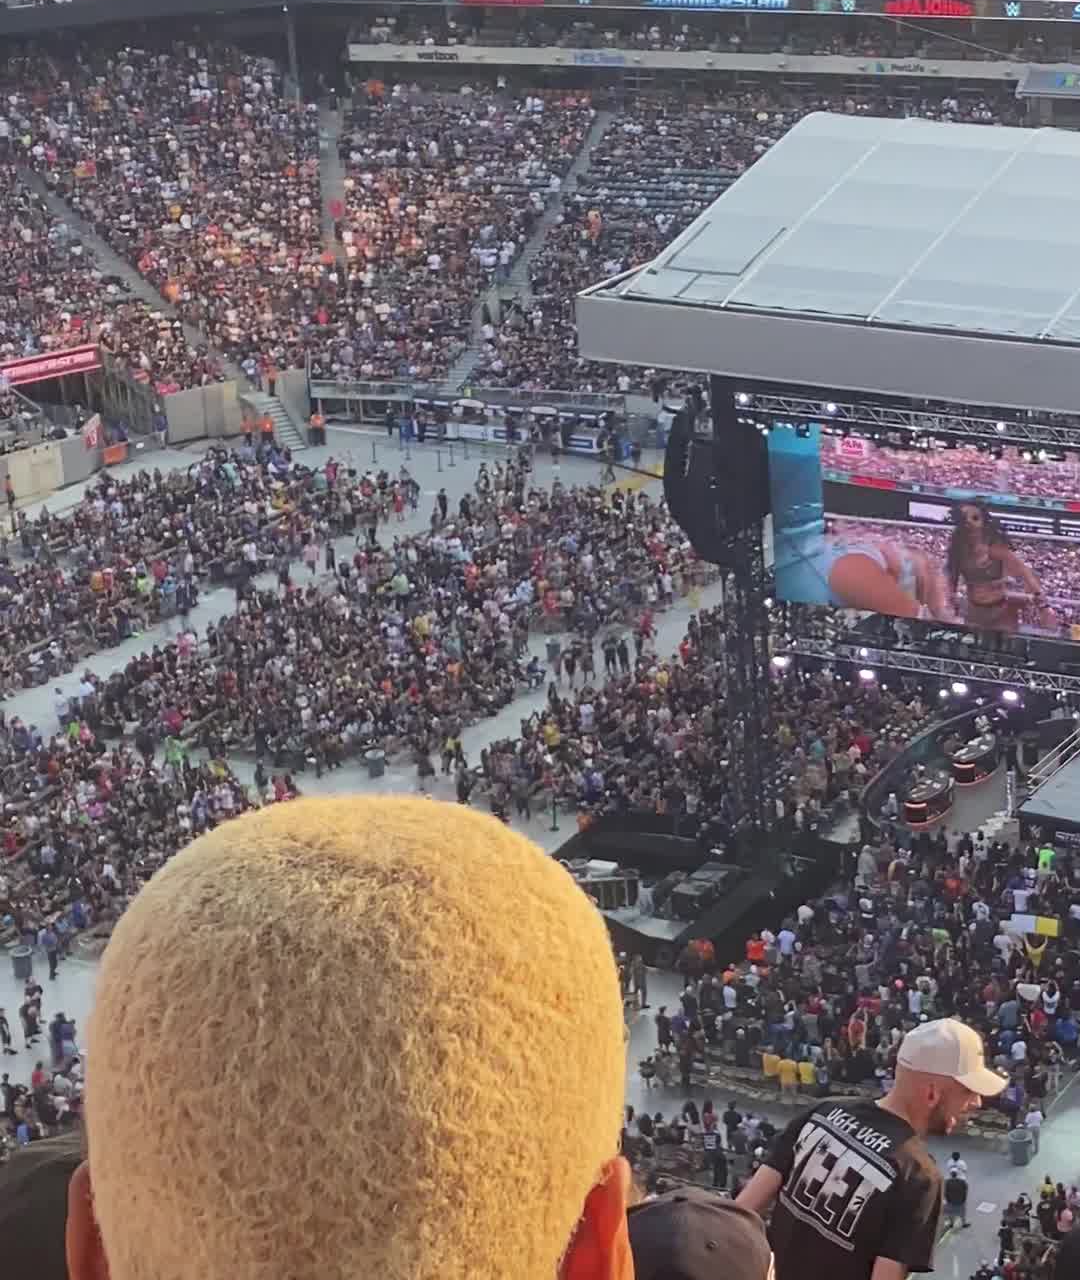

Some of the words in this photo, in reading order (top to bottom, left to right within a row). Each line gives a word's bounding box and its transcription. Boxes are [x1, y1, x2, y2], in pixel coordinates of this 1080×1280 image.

[826, 1107, 859, 1134] UGH
[856, 1126, 893, 1153] UGH
[782, 1121, 896, 1239] YEET
